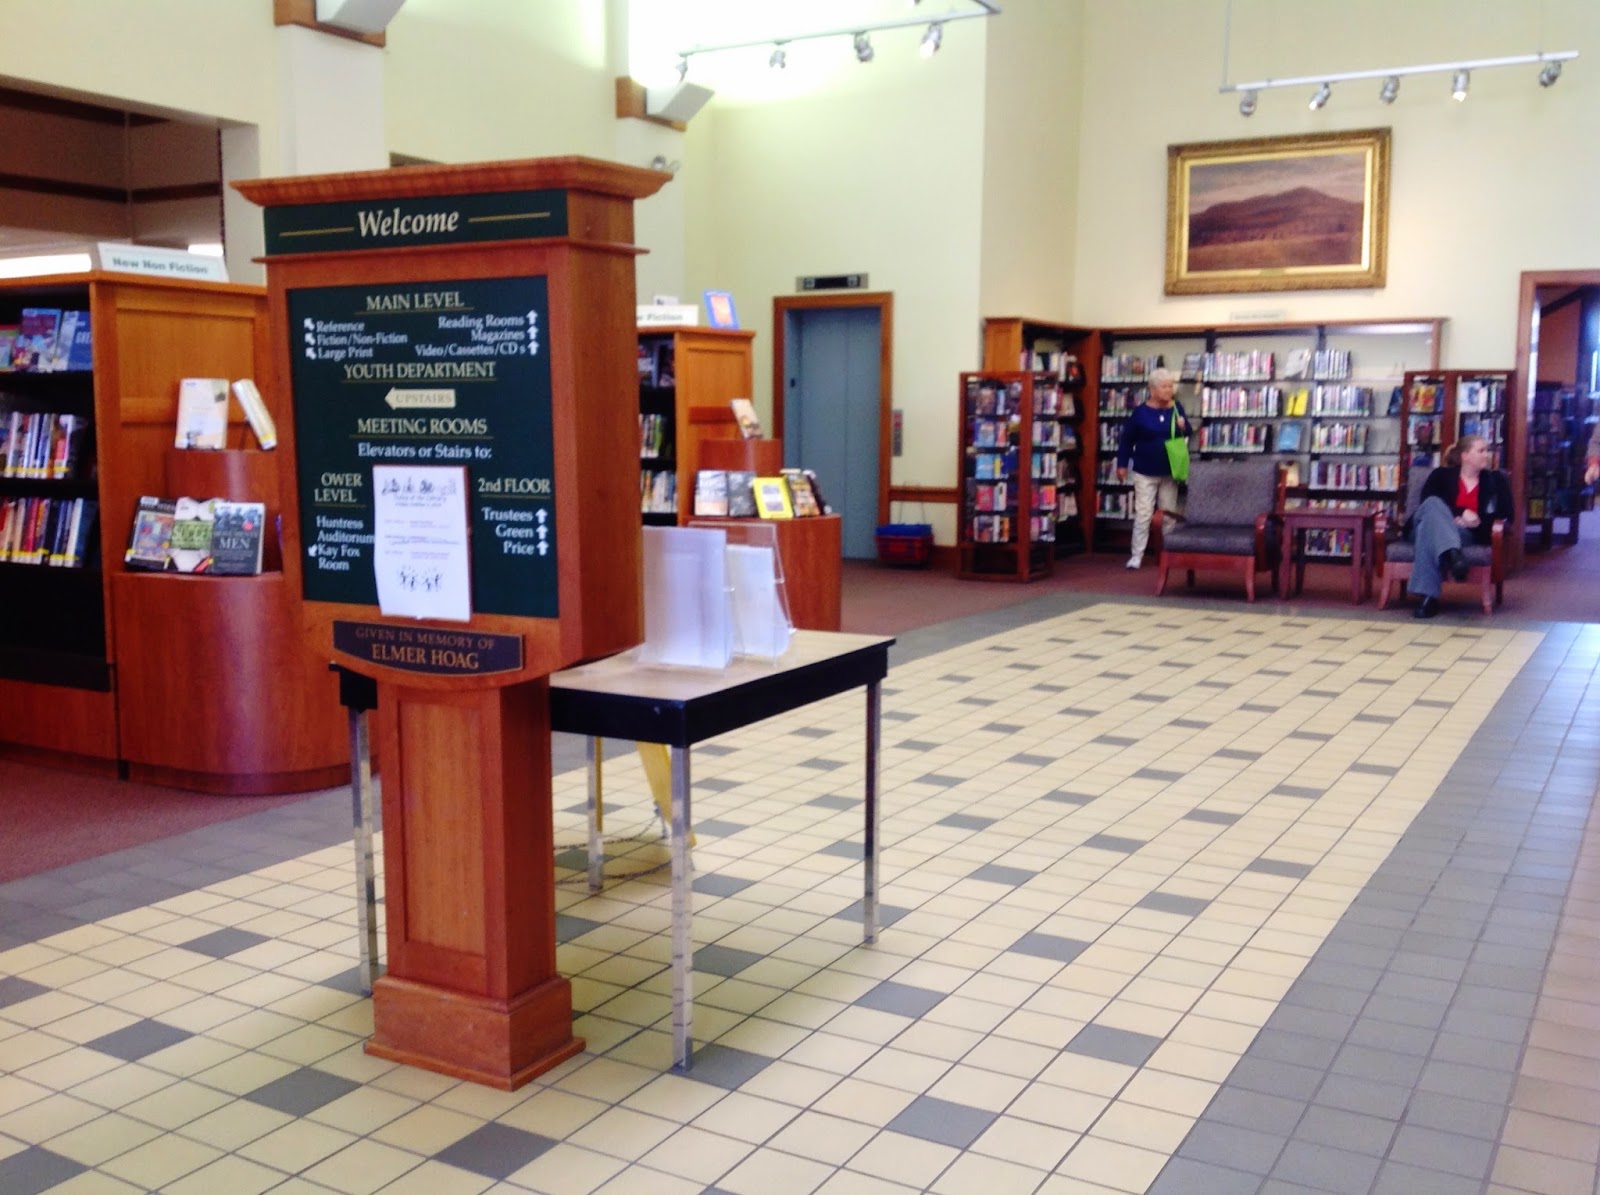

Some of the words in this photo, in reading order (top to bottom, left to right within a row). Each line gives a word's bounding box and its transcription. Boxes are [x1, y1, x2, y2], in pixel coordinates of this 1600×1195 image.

[357, 207, 460, 238] Welcome
[112, 257, 139, 268] New
[142, 260, 166, 270] Non
[169, 262, 208, 274] Fiction
[366, 293, 411, 311] MAIN
[414, 291, 465, 308] LEVEL
[316, 320, 365, 333] Reference
[438, 315, 483, 329] Reading
[485, 314, 525, 327] Rooms
[317, 332, 408, 346] Fiction/Non-Fiction
[470, 329, 525, 344] Magazines
[318, 347, 347, 362] Large
[348, 346, 373, 358] Print
[343, 364, 394, 379] YOUTH
[397, 361, 497, 378] DEPARTMENT
[395, 392, 453, 404] UPSTAIRS
[357, 418, 427, 434] MEETING
[430, 418, 488, 435] ROOMS
[357, 442, 416, 457] Elevators
[418, 447, 433, 457] or
[434, 443, 472, 459] Stairs
[474, 446, 493, 460] to:
[320, 472, 363, 487] OWER
[478, 478, 502, 493] 2nd
[504, 478, 551, 494] FLOOR
[314, 488, 358, 503] LEVEL
[316, 515, 364, 529] Huntress
[482, 507, 534, 522] Trustees
[317, 530, 375, 544] Auditorium
[495, 524, 534, 538] Green
[219, 538, 250, 550] MEN
[503, 541, 535, 555] Price
[318, 544, 339, 560] Kay
[340, 544, 361, 558] Fox
[318, 556, 351, 571] Room
[355, 626, 395, 641] GIVEN
[399, 631, 413, 643] IN
[417, 633, 473, 648] MEMORY
[477, 637, 496, 651] OF
[371, 643, 426, 665] ELMER
[431, 649, 480, 670] HOAG
